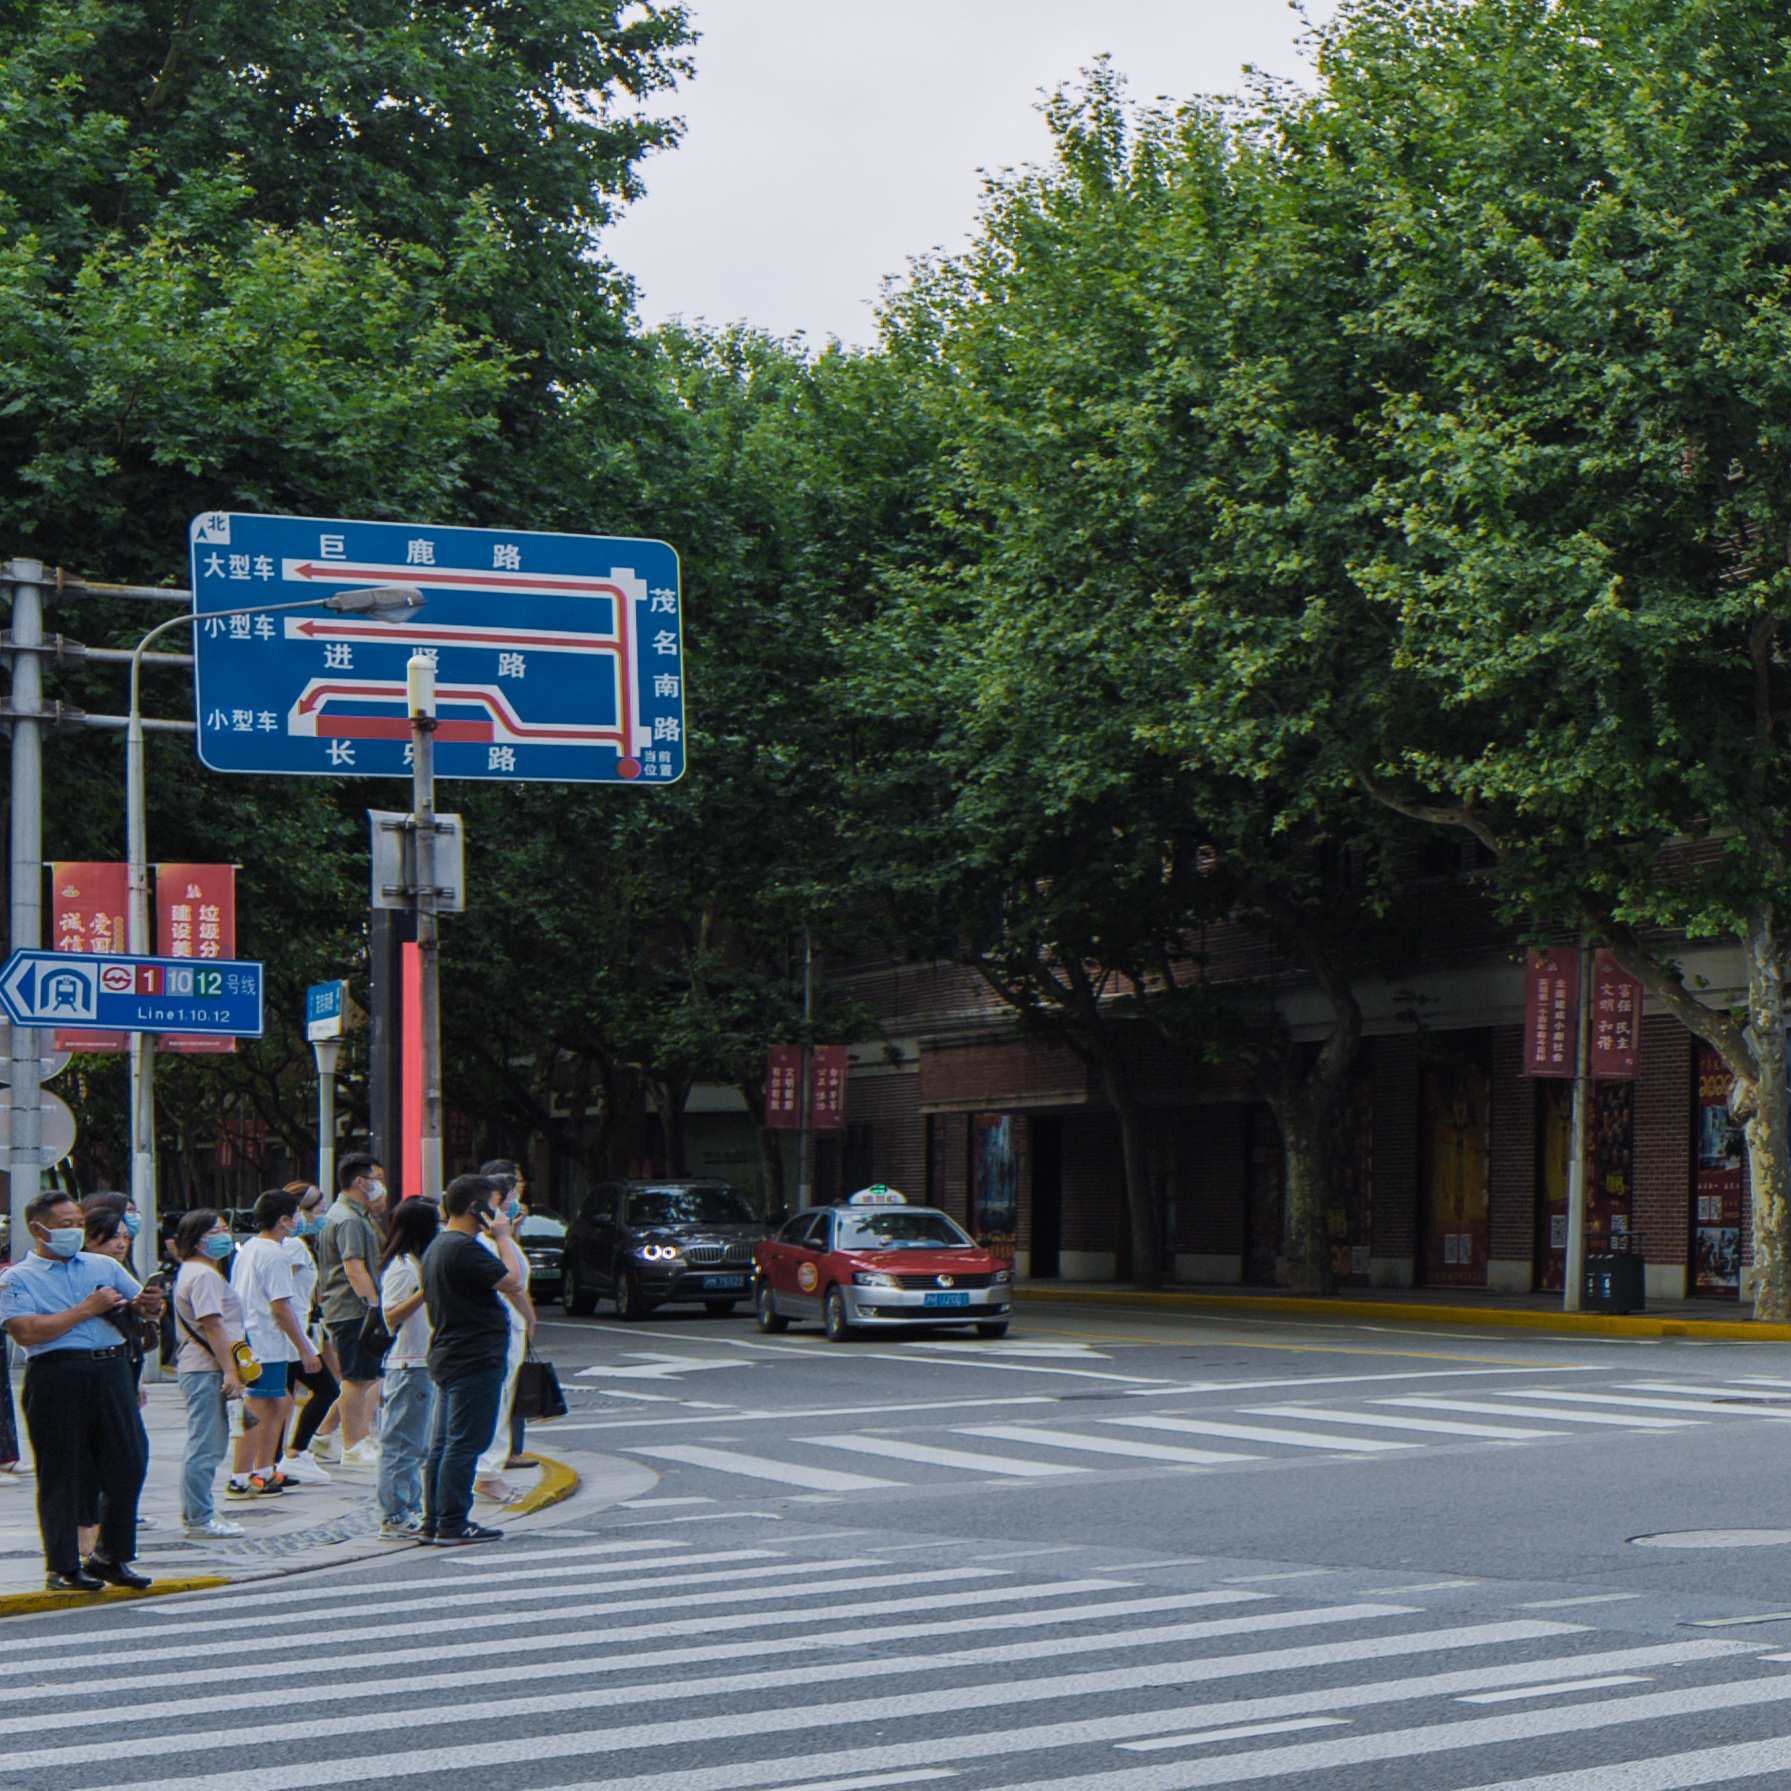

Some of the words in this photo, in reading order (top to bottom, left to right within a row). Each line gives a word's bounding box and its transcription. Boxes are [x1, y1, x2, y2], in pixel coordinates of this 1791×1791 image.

[207, 515, 226, 532] 北
[319, 534, 522, 571] 巨鹿路
[203, 551, 276, 582] 大型车
[203, 614, 277, 641] 小型车
[648, 587, 682, 743] 茂名南路
[206, 708, 279, 733] 小型车
[644, 750, 672, 763] 当前
[643, 764, 673, 777] 位置
[143, 969, 155, 992] 1
[168, 971, 192, 993] 10
[196, 972, 222, 995] 12
[225, 973, 257, 996] 号线
